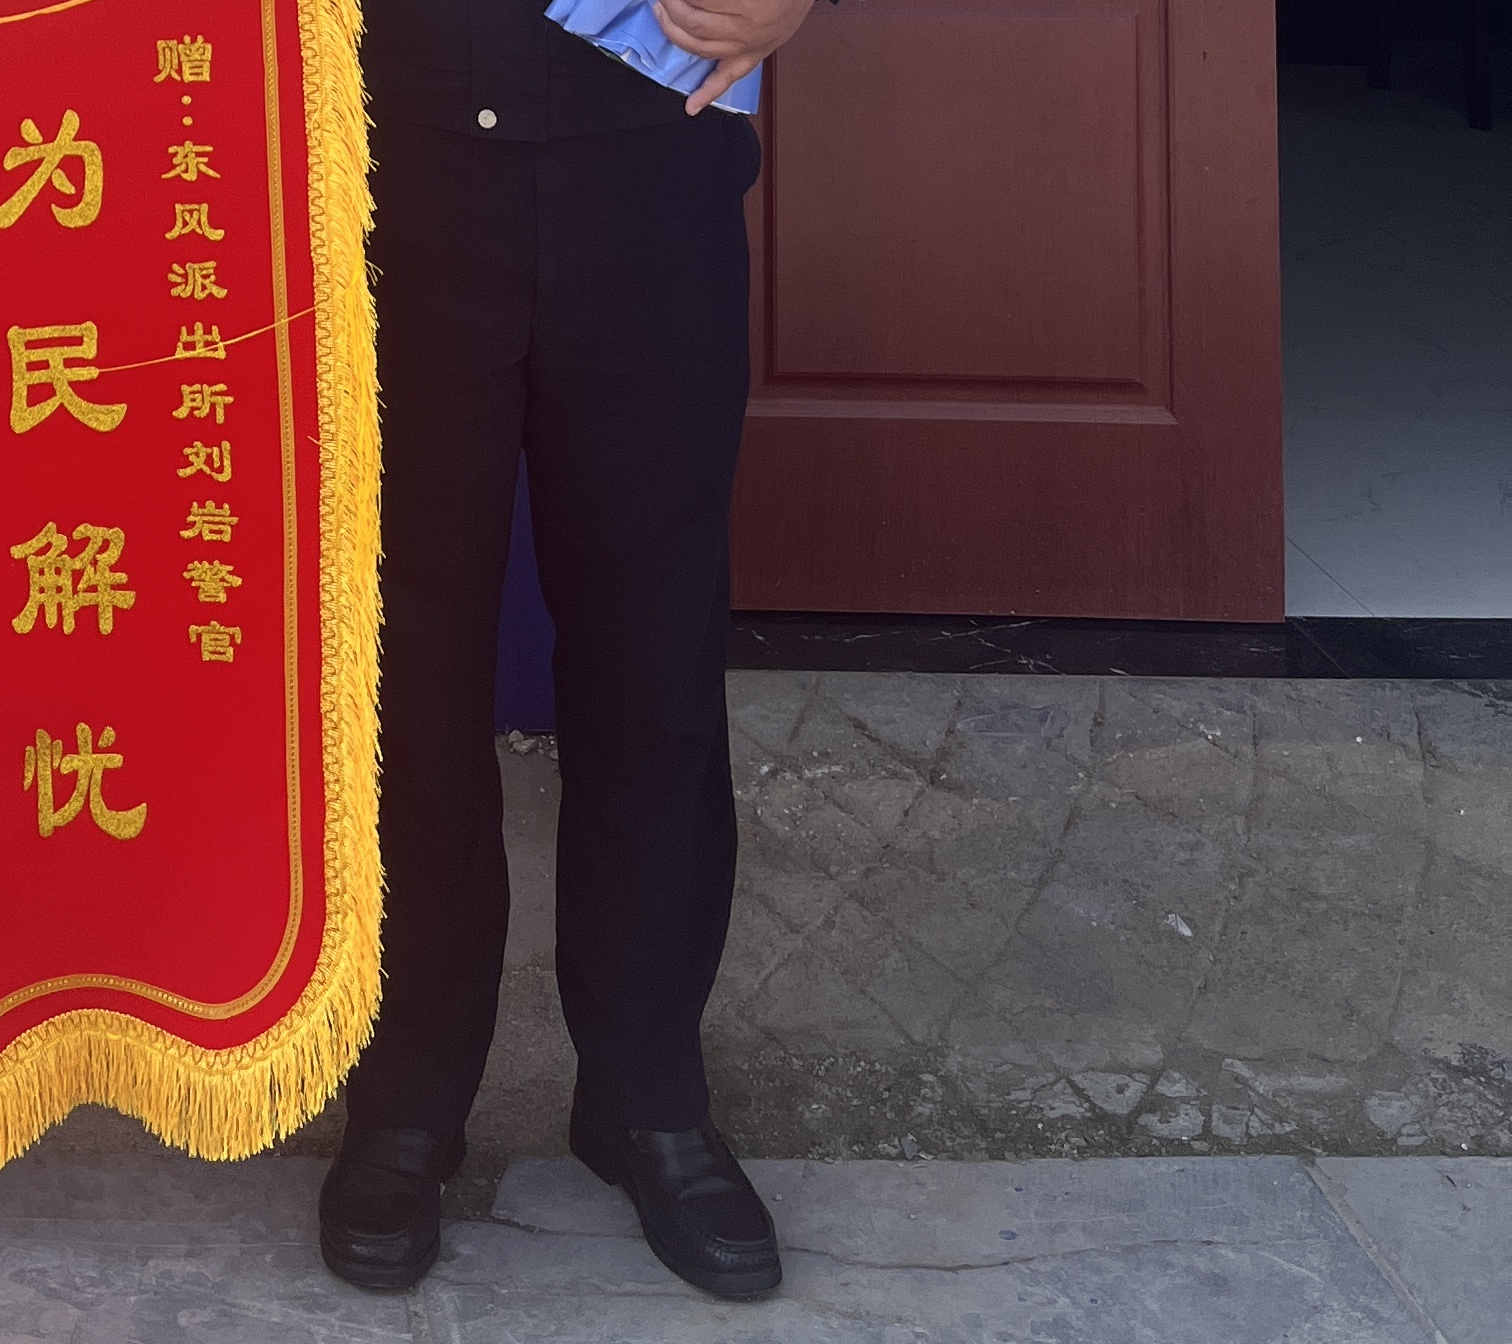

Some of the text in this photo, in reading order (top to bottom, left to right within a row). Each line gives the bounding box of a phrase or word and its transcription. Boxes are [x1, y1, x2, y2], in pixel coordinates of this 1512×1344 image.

[153, 34, 243, 663] 赠：东风派出所刘岩警官
